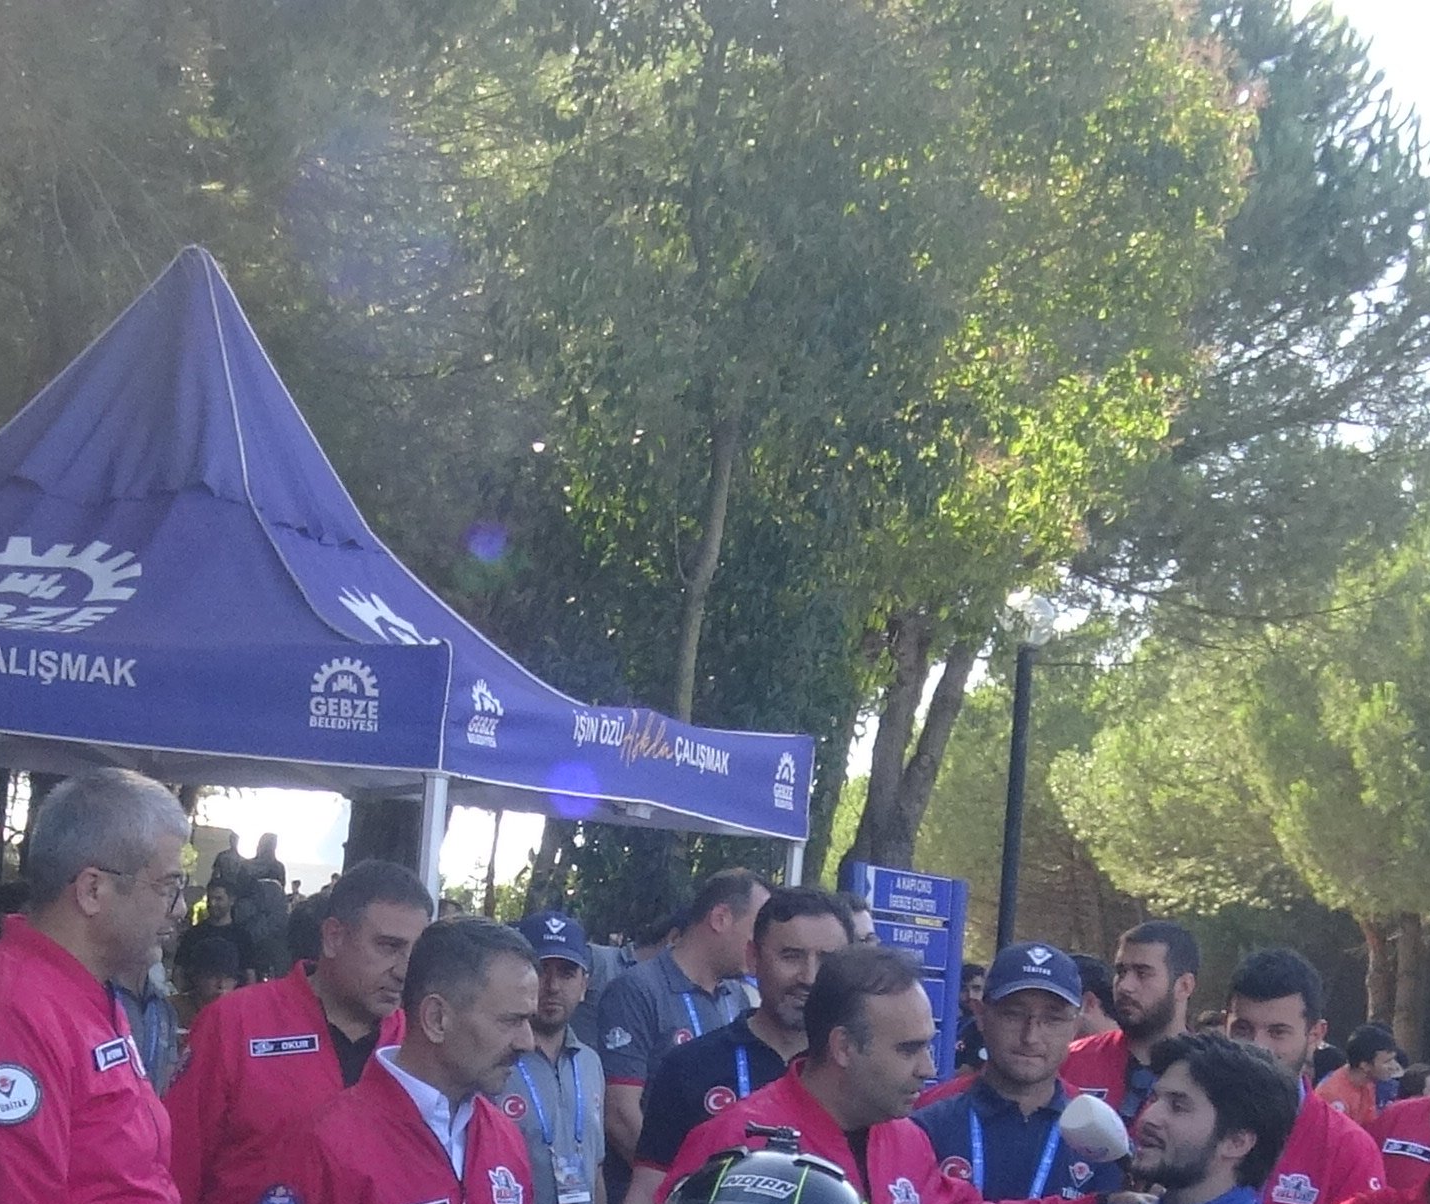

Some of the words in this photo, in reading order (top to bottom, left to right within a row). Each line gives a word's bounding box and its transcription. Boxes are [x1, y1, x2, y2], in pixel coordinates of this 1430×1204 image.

[309, 696, 379, 719] GEBZE
[309, 716, 379, 732] BELEDİYESİ
[573, 709, 599, 747] İŞİN
[599, 713, 625, 747] ÖZÜ
[674, 736, 731, 775] ÇALIŞMAK
[723, 1175, 796, 1193] NOLAN
